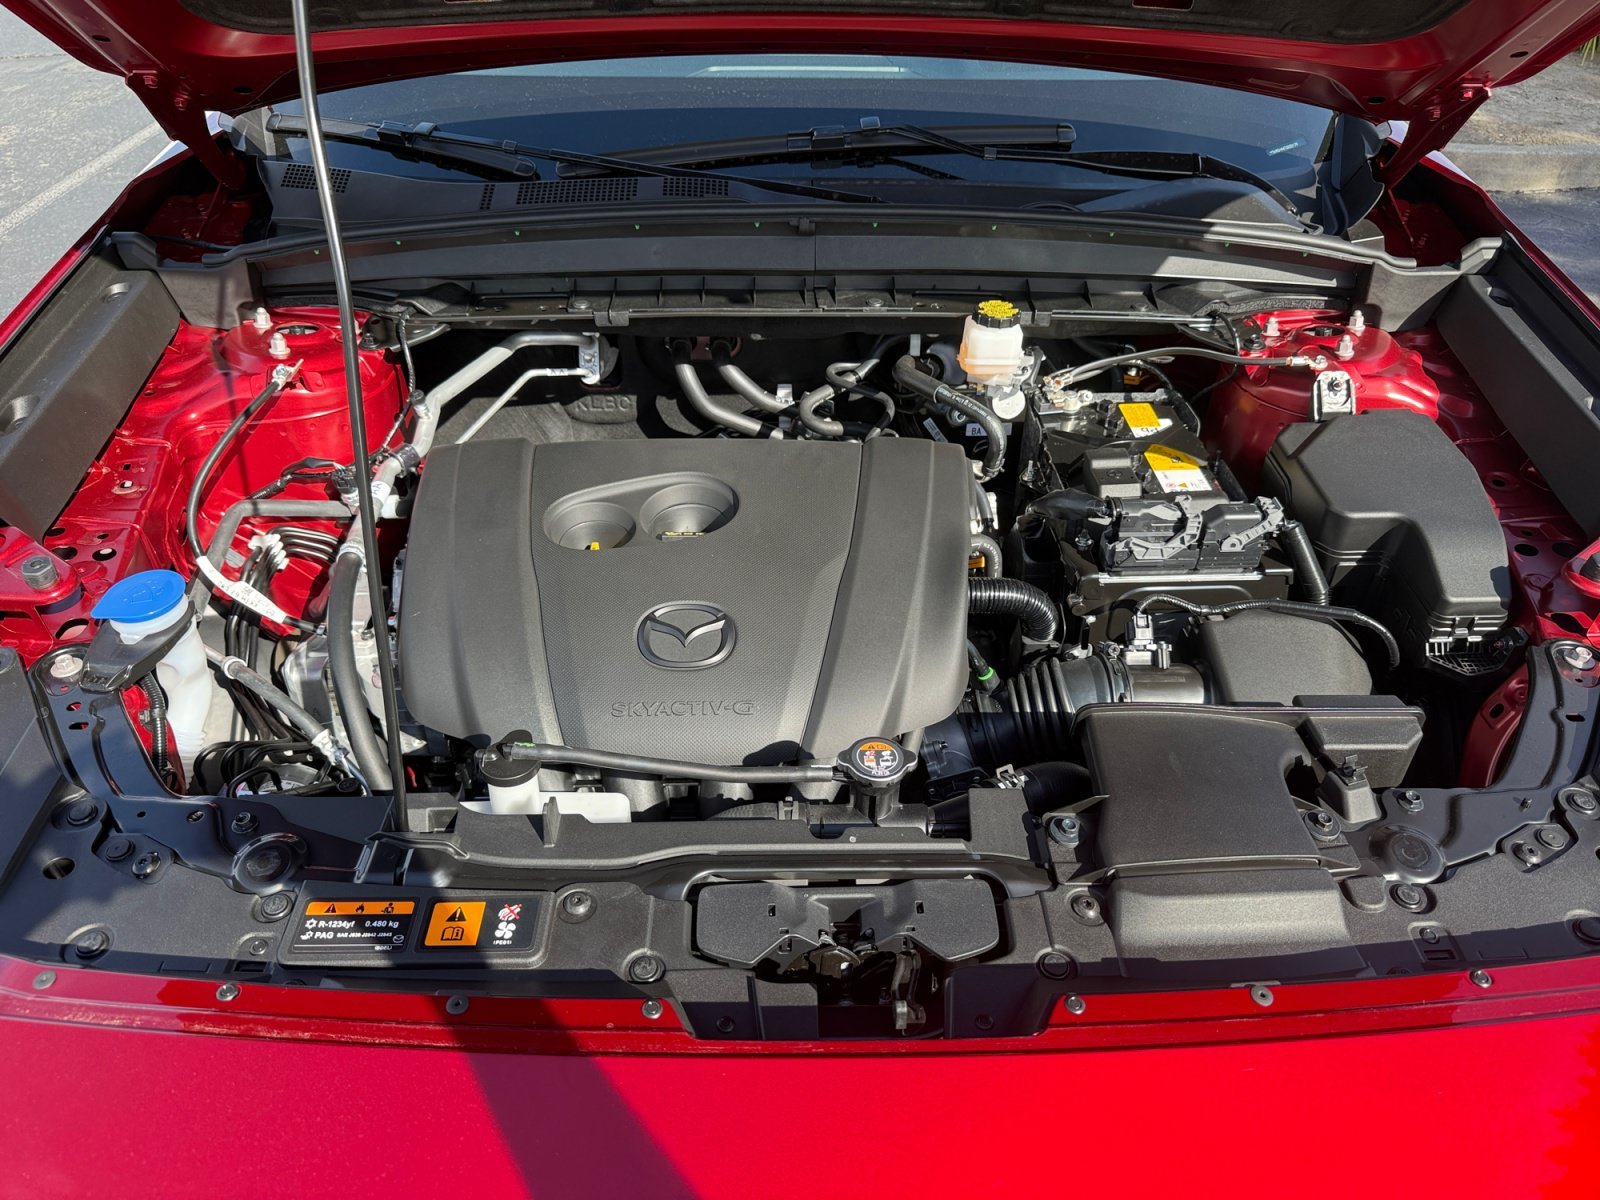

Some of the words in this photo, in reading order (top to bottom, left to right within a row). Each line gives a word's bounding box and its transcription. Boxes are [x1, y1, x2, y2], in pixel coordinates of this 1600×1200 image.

[971, 427, 982, 436] BA
[610, 700, 754, 717] SKYACTIV-G
[317, 920, 355, 929] R-1234yf
[365, 920, 387, 928] 0.480
[388, 920, 399, 929] kg
[314, 931, 334, 939] PAG
